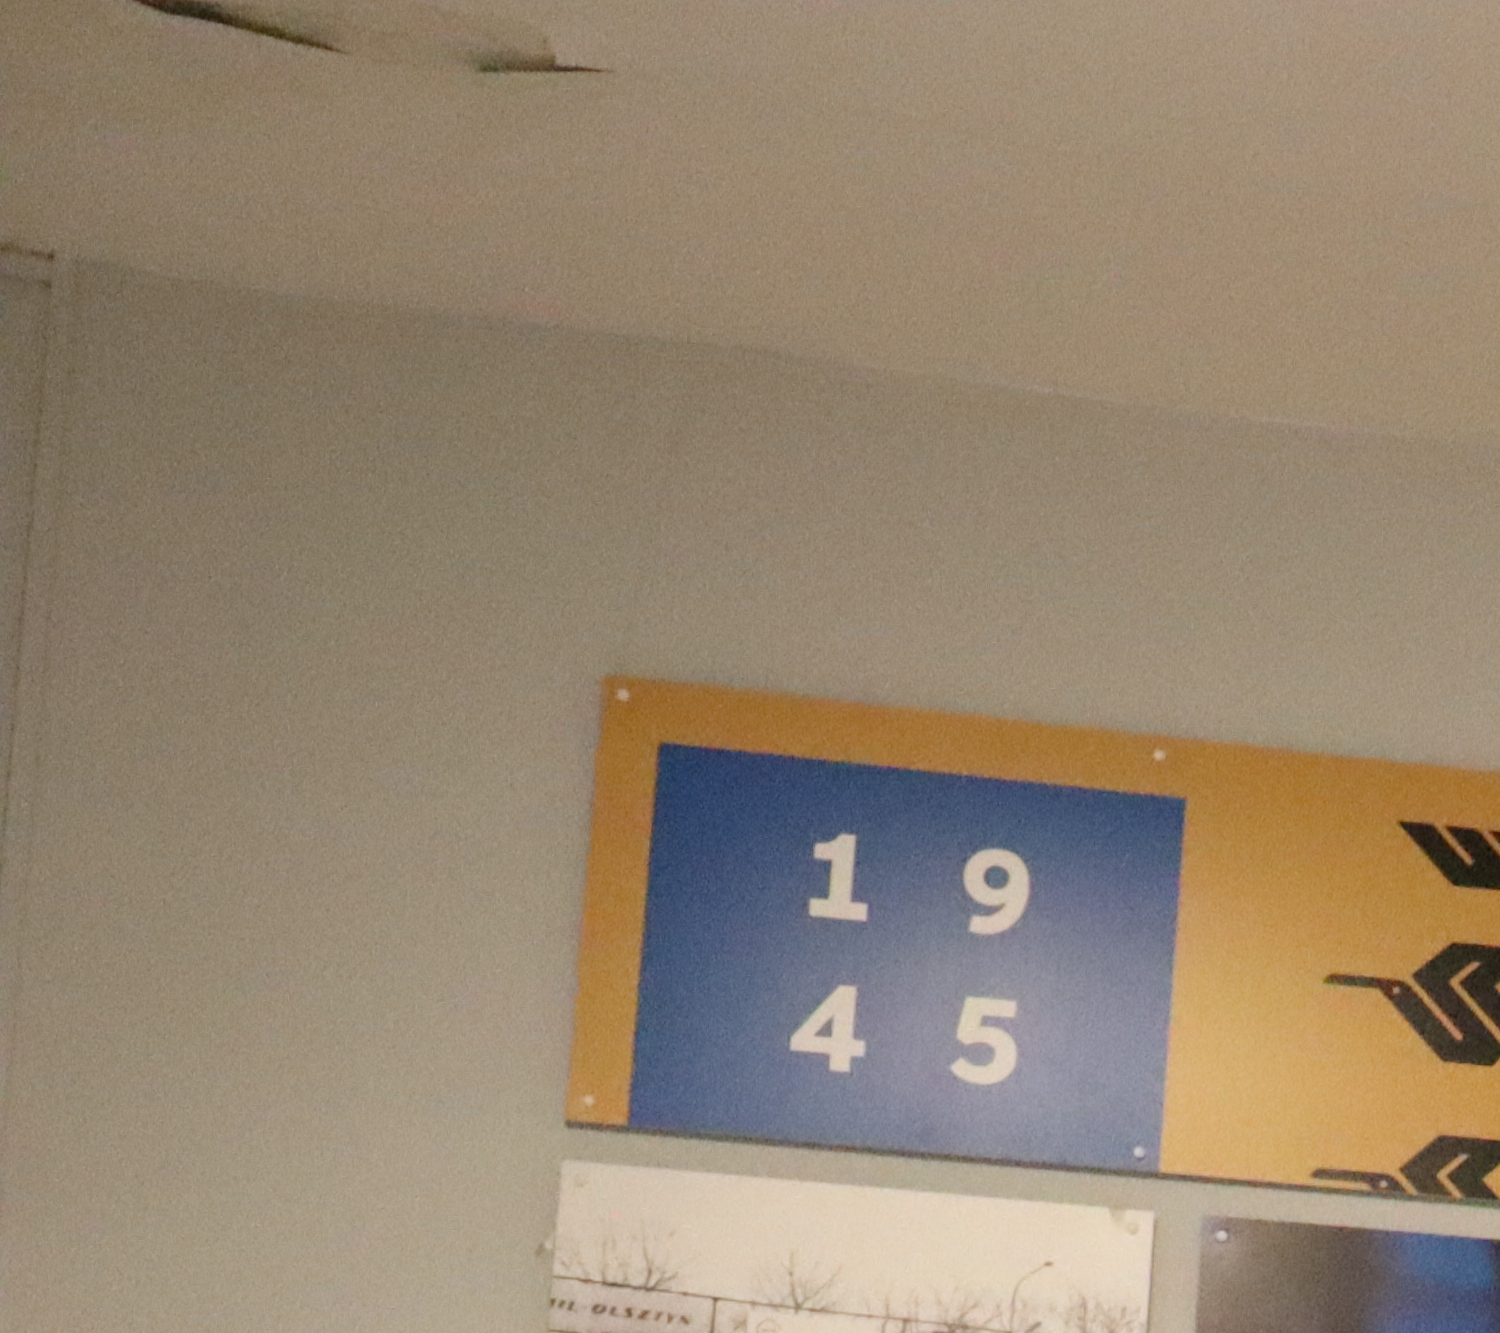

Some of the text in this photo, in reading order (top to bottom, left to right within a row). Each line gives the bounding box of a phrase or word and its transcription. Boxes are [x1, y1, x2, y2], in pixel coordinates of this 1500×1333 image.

[808, 833, 1031, 935] 1 9
[790, 985, 1017, 1085] 4 5
